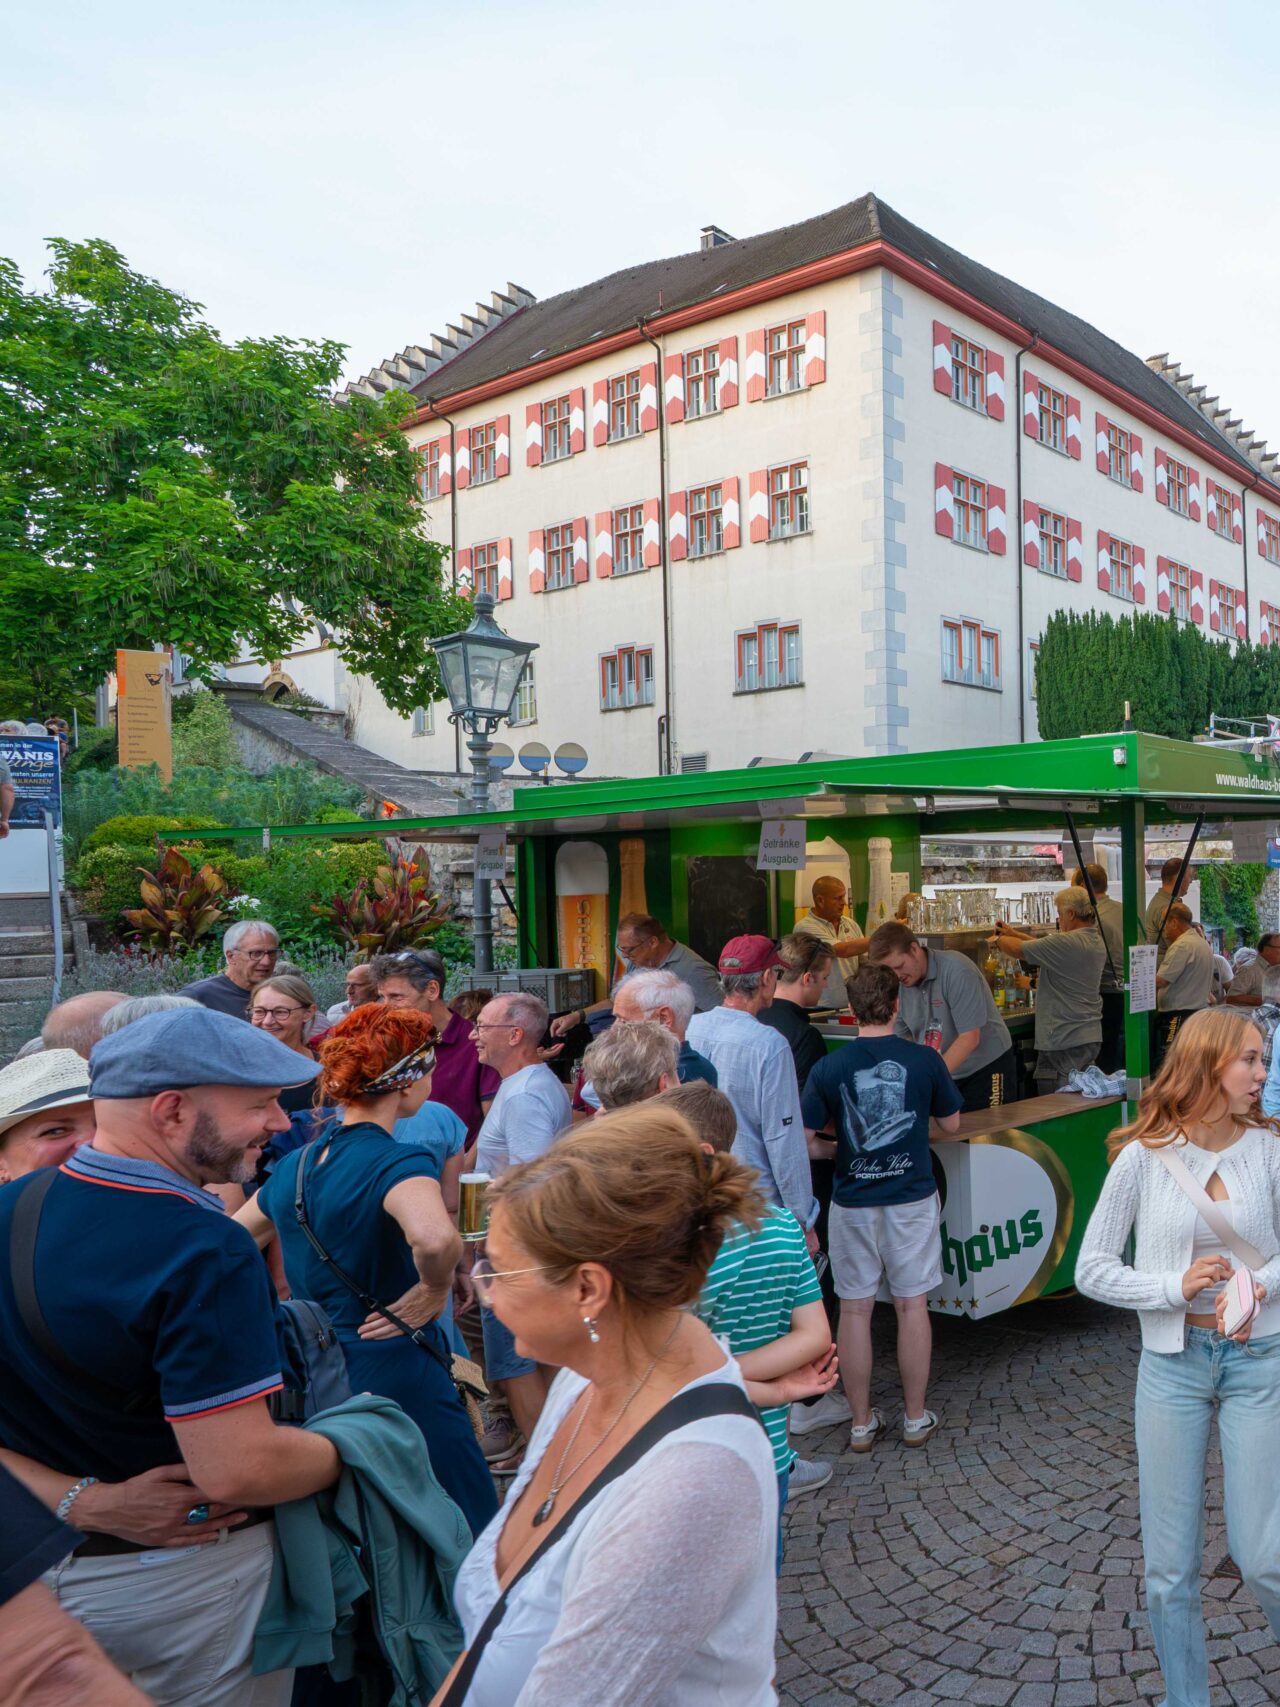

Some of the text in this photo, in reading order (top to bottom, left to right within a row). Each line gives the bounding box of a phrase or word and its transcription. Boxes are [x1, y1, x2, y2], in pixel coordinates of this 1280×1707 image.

[763, 838, 801, 848] Getränke
[762, 853, 799, 865] Ausgabe
[886, 1152, 913, 1171] Vita
